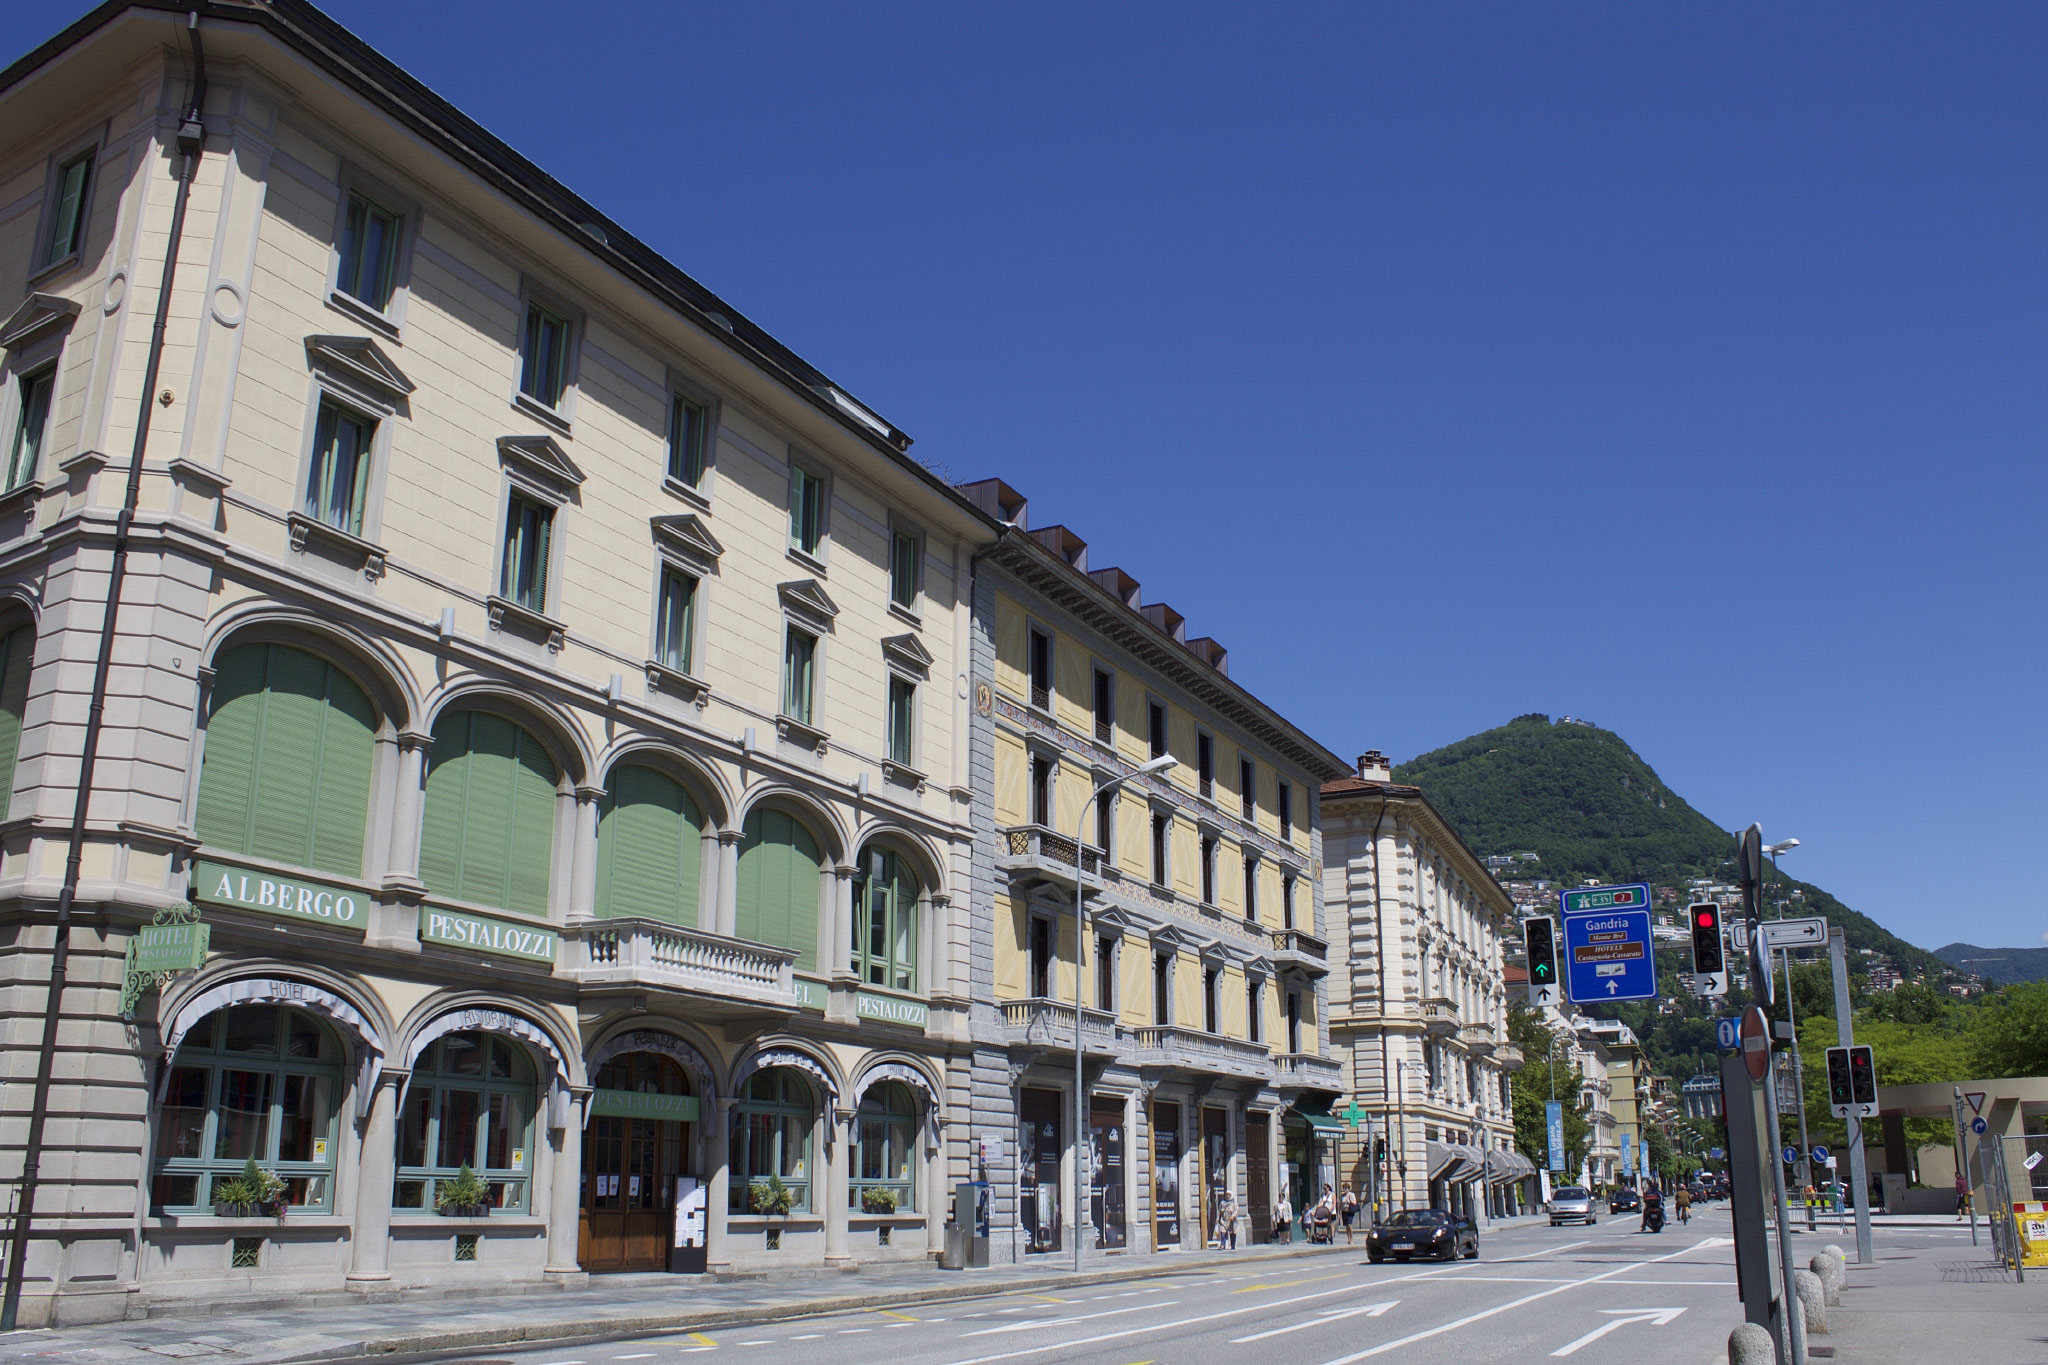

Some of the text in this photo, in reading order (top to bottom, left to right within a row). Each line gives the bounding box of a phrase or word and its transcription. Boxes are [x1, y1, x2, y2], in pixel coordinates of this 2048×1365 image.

[214, 872, 355, 921] ALBERGO
[1599, 895, 1609, 903] 35
[1620, 893, 1625, 901] 2
[1585, 918, 1629, 931] Gandria
[142, 927, 193, 947] HOTEL
[428, 913, 552, 957] PESTALOZZI
[140, 947, 192, 960] PESTALOZZI
[1594, 944, 1623, 953] HOTELS
[269, 981, 309, 1000] HOTEL
[858, 996, 925, 1024] PESTALOZZI
[464, 1009, 520, 1031] RISTORANE
[596, 1091, 690, 1112] PESTALOZZI
